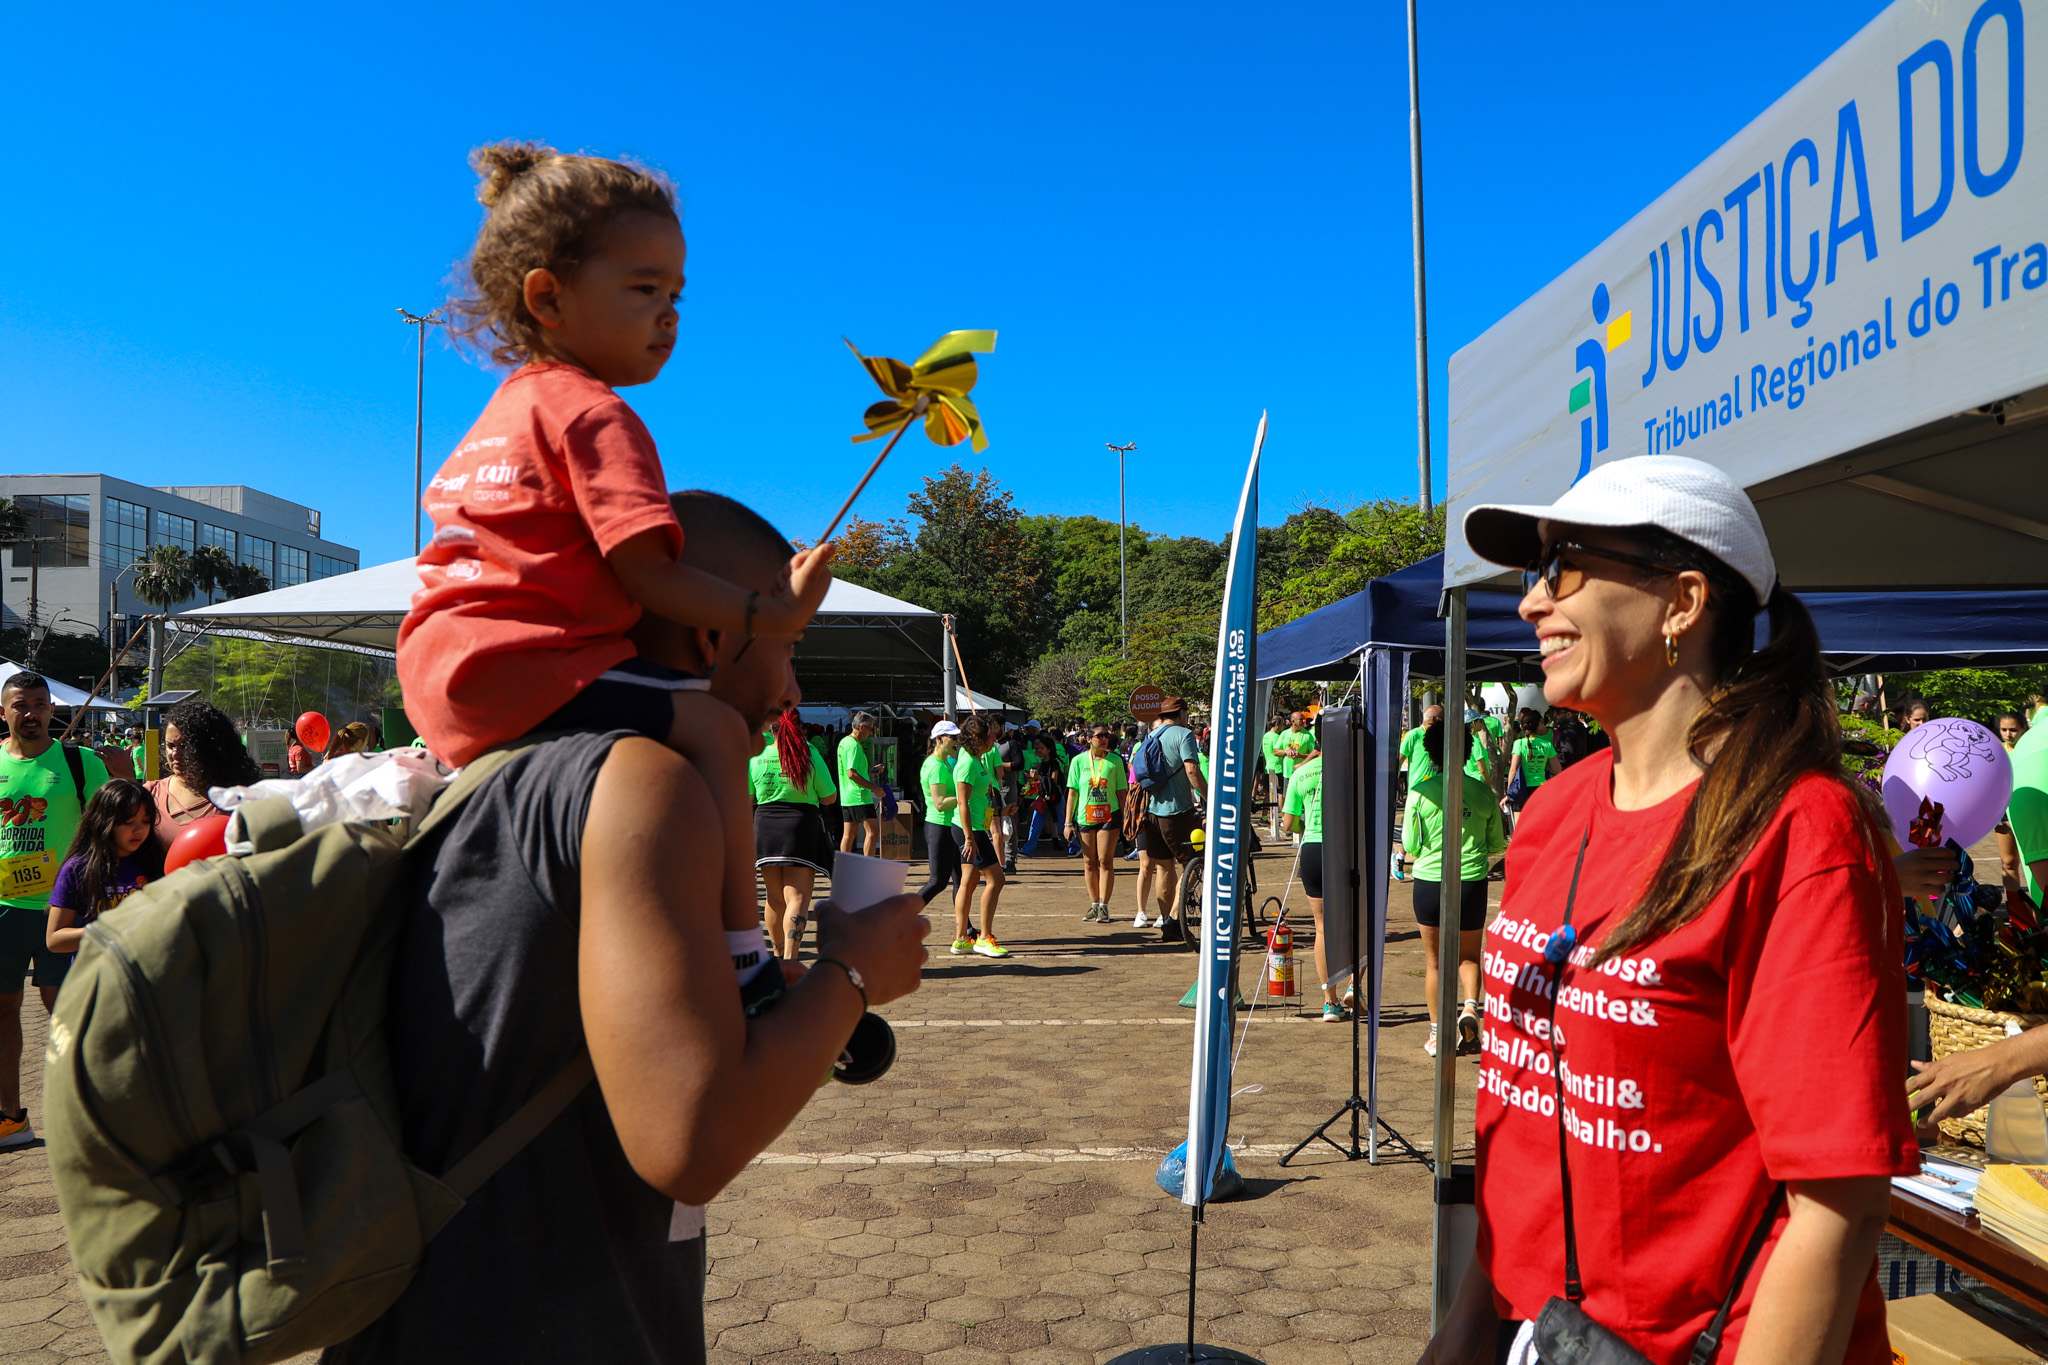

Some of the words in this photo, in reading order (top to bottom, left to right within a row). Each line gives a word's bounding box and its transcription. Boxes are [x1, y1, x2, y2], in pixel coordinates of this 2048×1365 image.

[1642, 99, 1879, 389] JUSTIÇA
[1896, 0, 2025, 243] DO
[1644, 374, 1743, 455] Tribunal
[1751, 297, 1896, 412] Regional
[1907, 277, 1960, 338] do
[1135, 693, 1160, 701] POSSO
[1, 827, 45, 841] CORRIDA
[13, 840, 45, 852] VIDA
[12, 866, 41, 884] 1135
